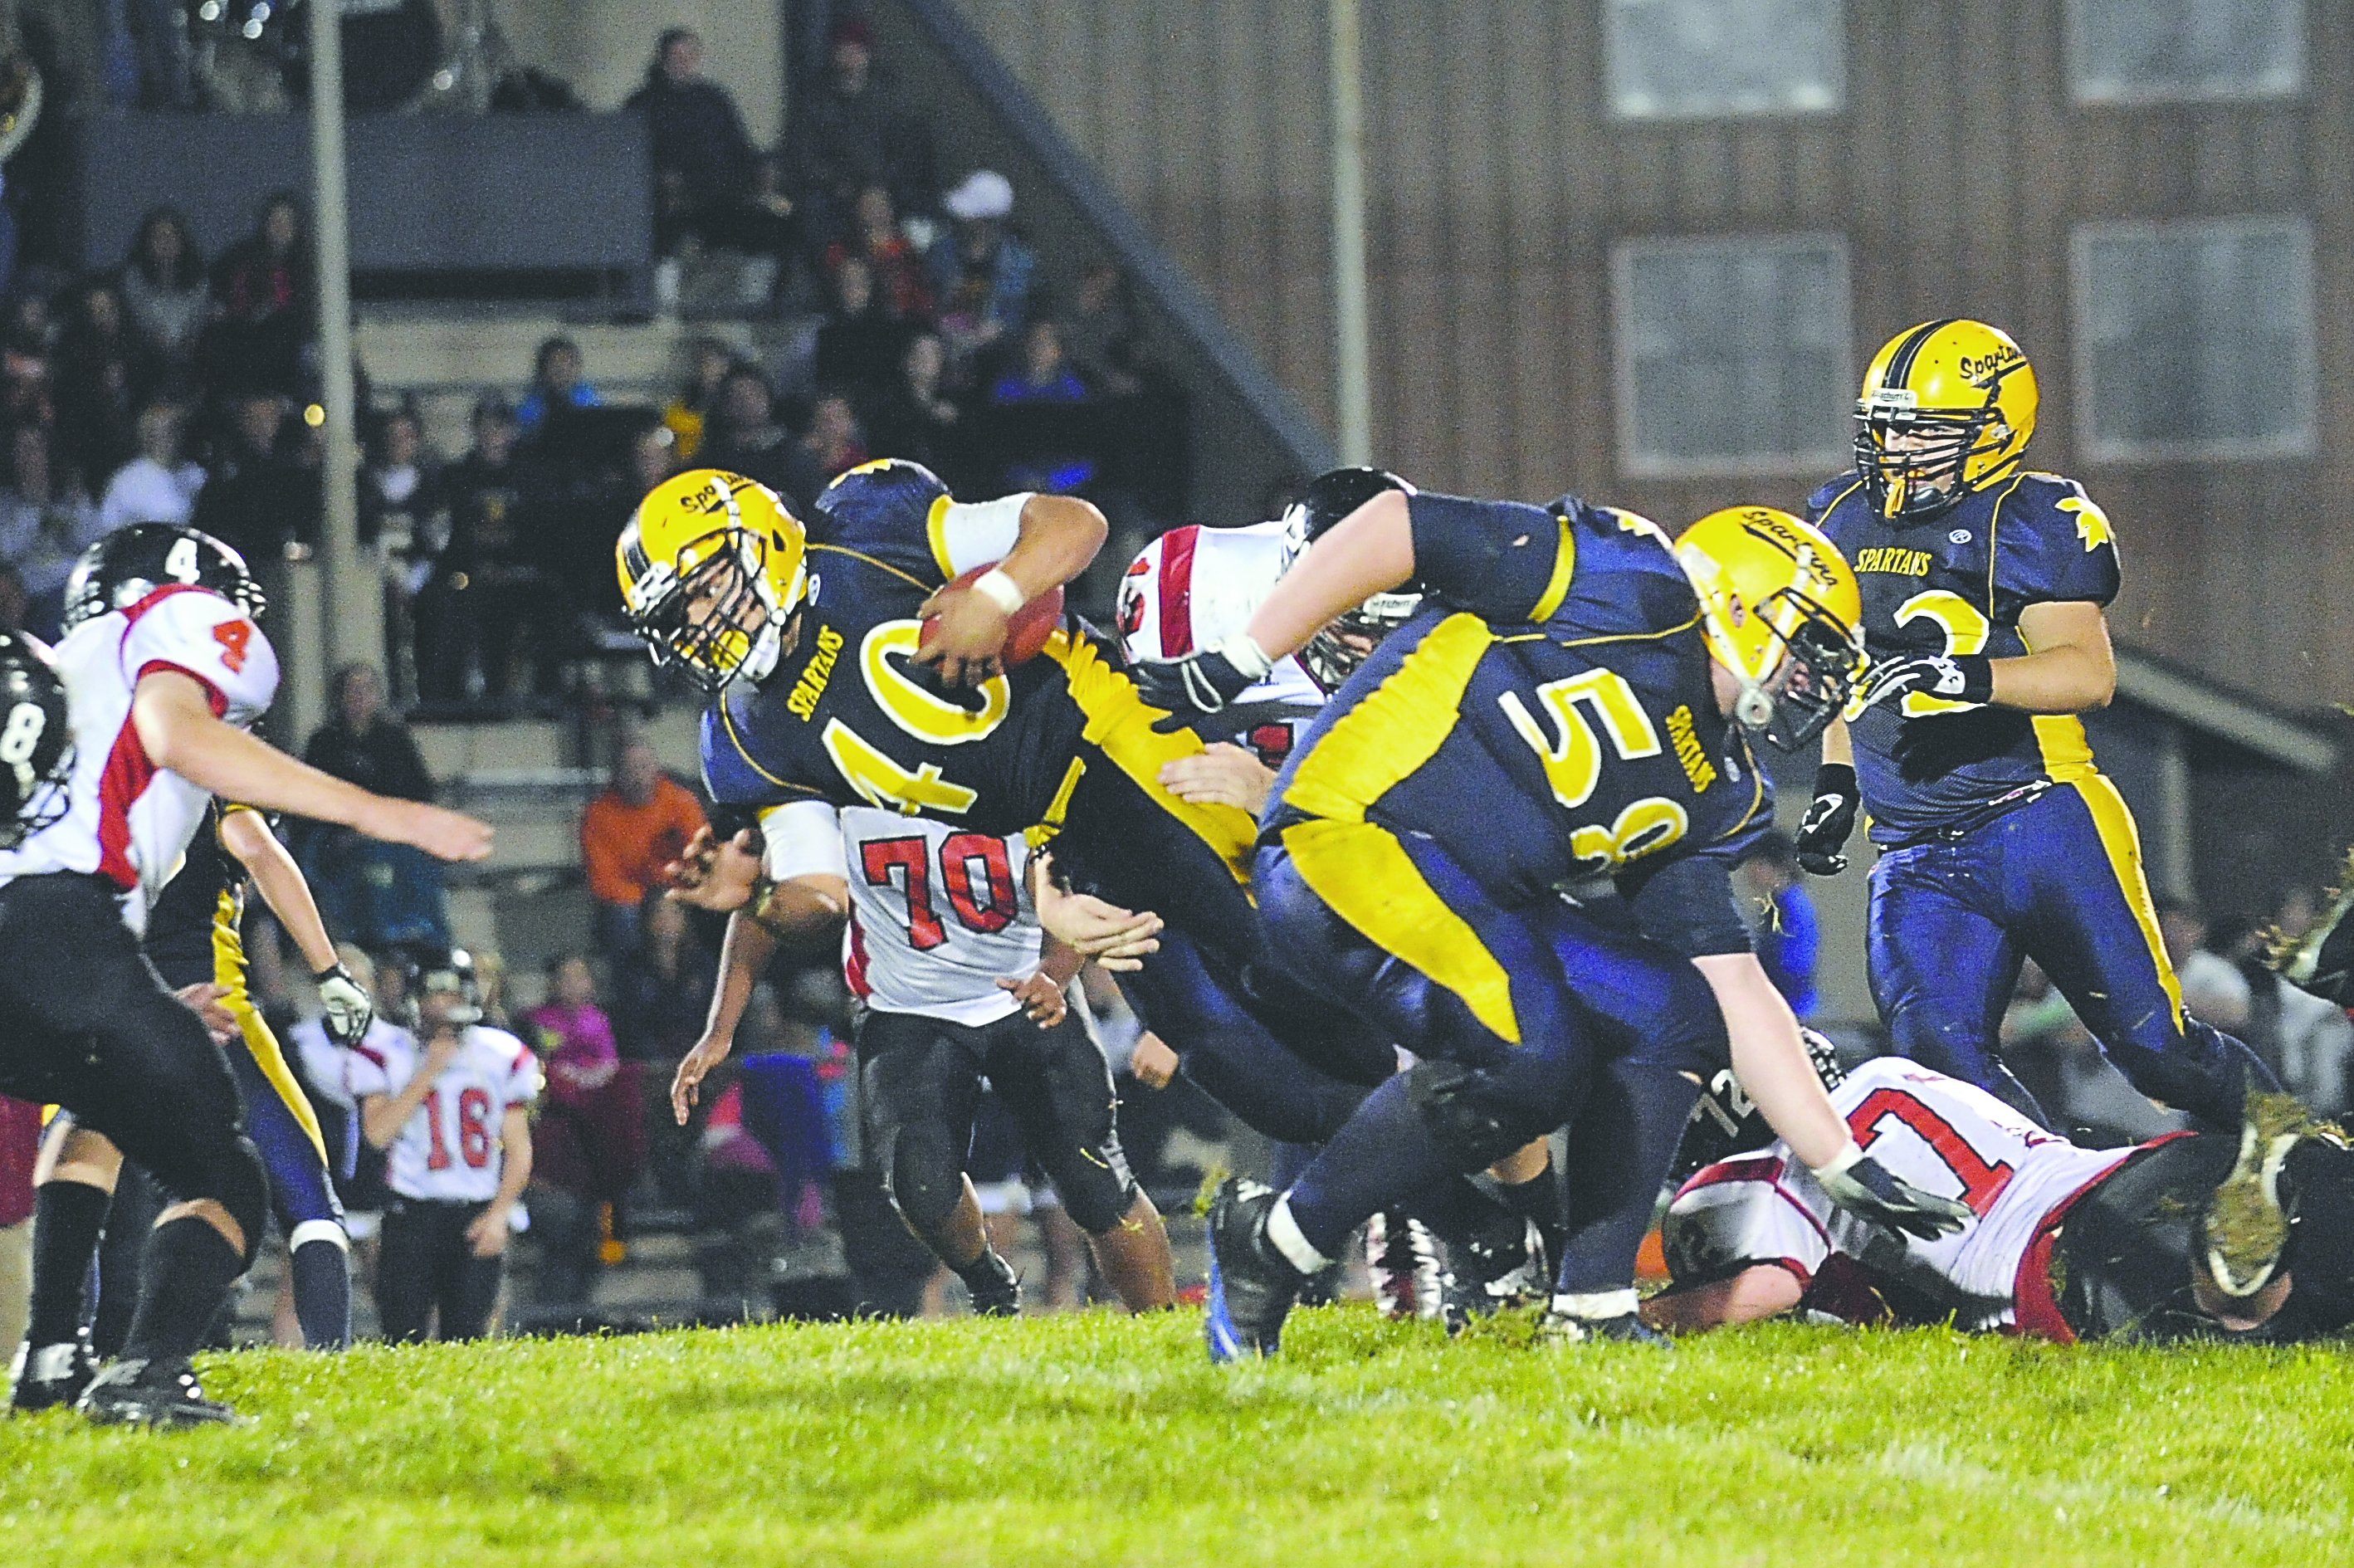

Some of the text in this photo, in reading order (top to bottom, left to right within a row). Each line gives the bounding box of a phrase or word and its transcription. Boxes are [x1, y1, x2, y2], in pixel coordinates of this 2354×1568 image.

[165, 538, 200, 584] 4
[1741, 510, 1839, 586] Sparans
[1853, 547, 1932, 576] SPARTANS
[786, 624, 843, 722] SPARTANS
[821, 618, 1010, 814] 40
[1665, 705, 1717, 794] SPARTANS
[859, 830, 1018, 950] 70
[422, 1087, 490, 1170] 16
[1845, 1087, 2047, 1214] 7
